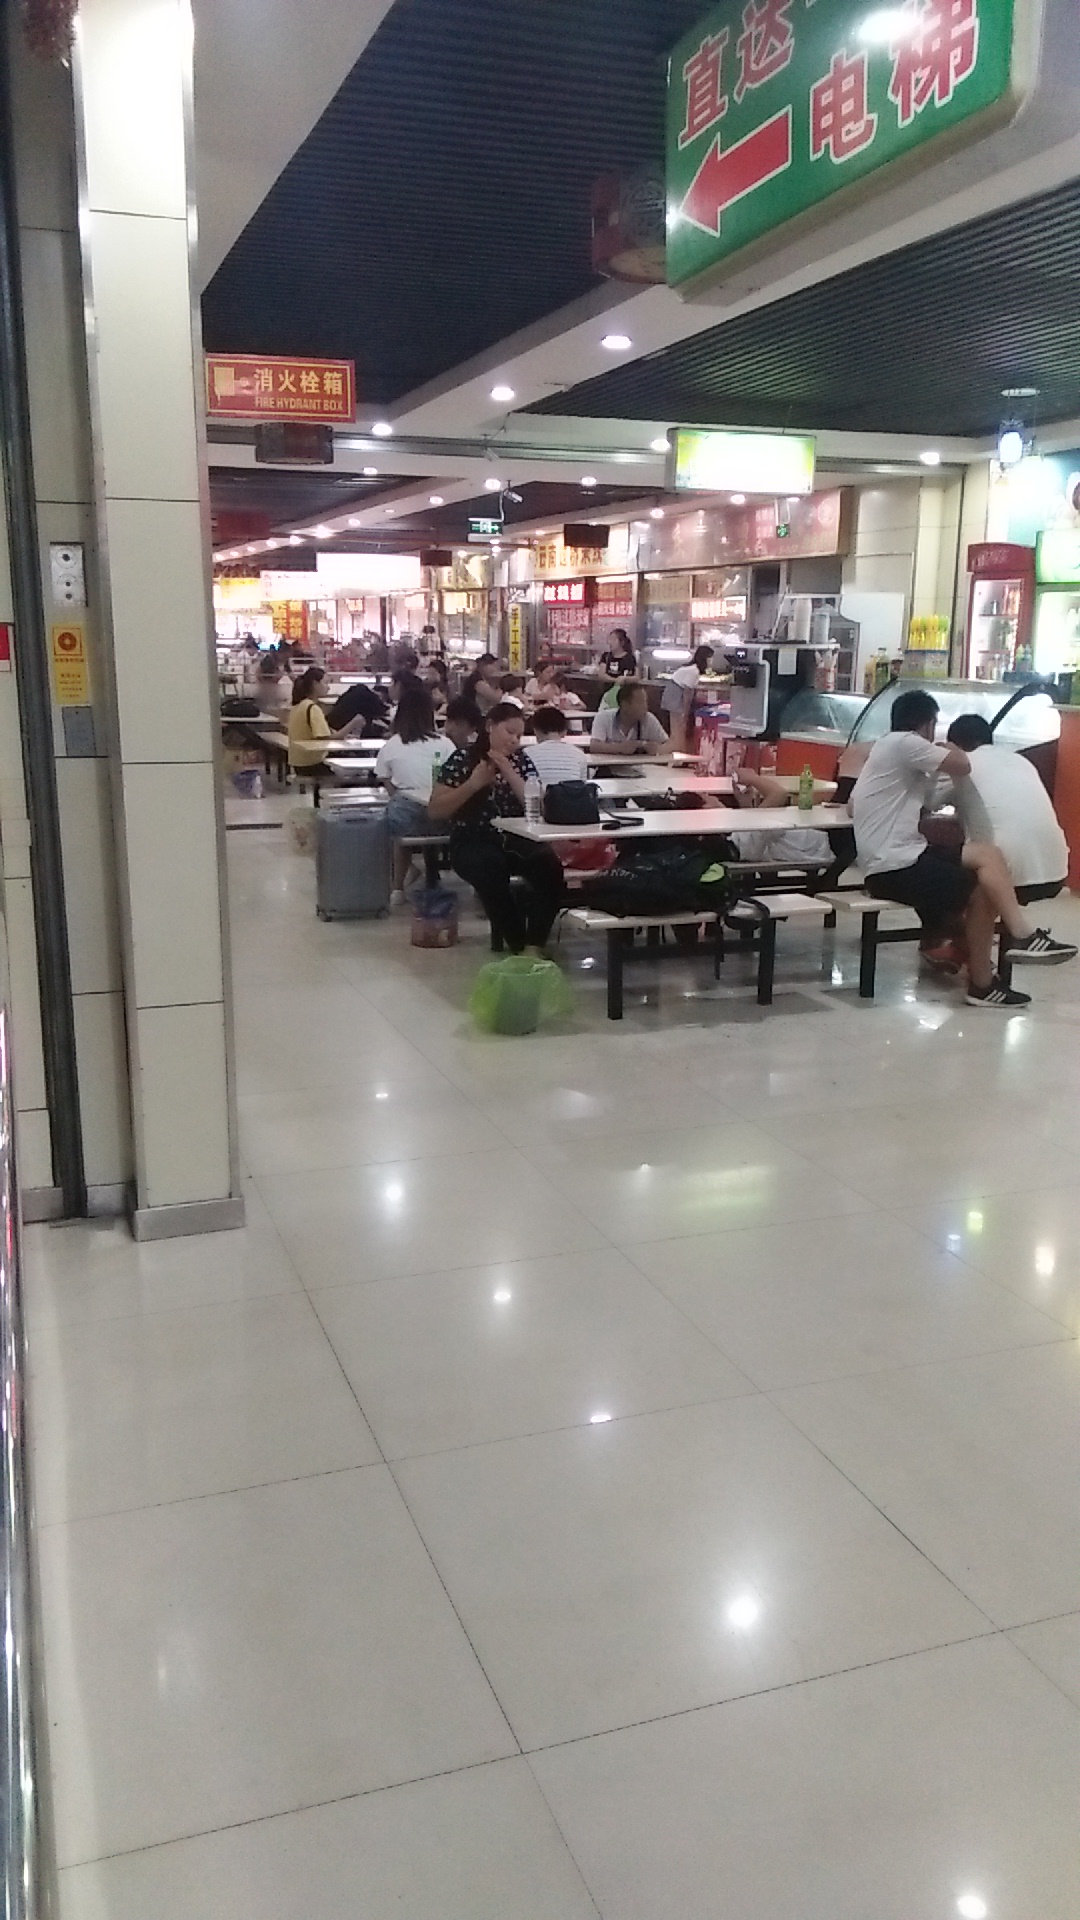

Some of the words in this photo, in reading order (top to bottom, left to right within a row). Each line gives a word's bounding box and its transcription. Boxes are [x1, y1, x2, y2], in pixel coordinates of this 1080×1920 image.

[810, 0, 979, 163] 电梯
[254, 368, 343, 395] 消火栓箱
[255, 396, 275, 408] FIRE
[277, 398, 321, 411] HYDRANT
[323, 400, 343, 411] BOX
